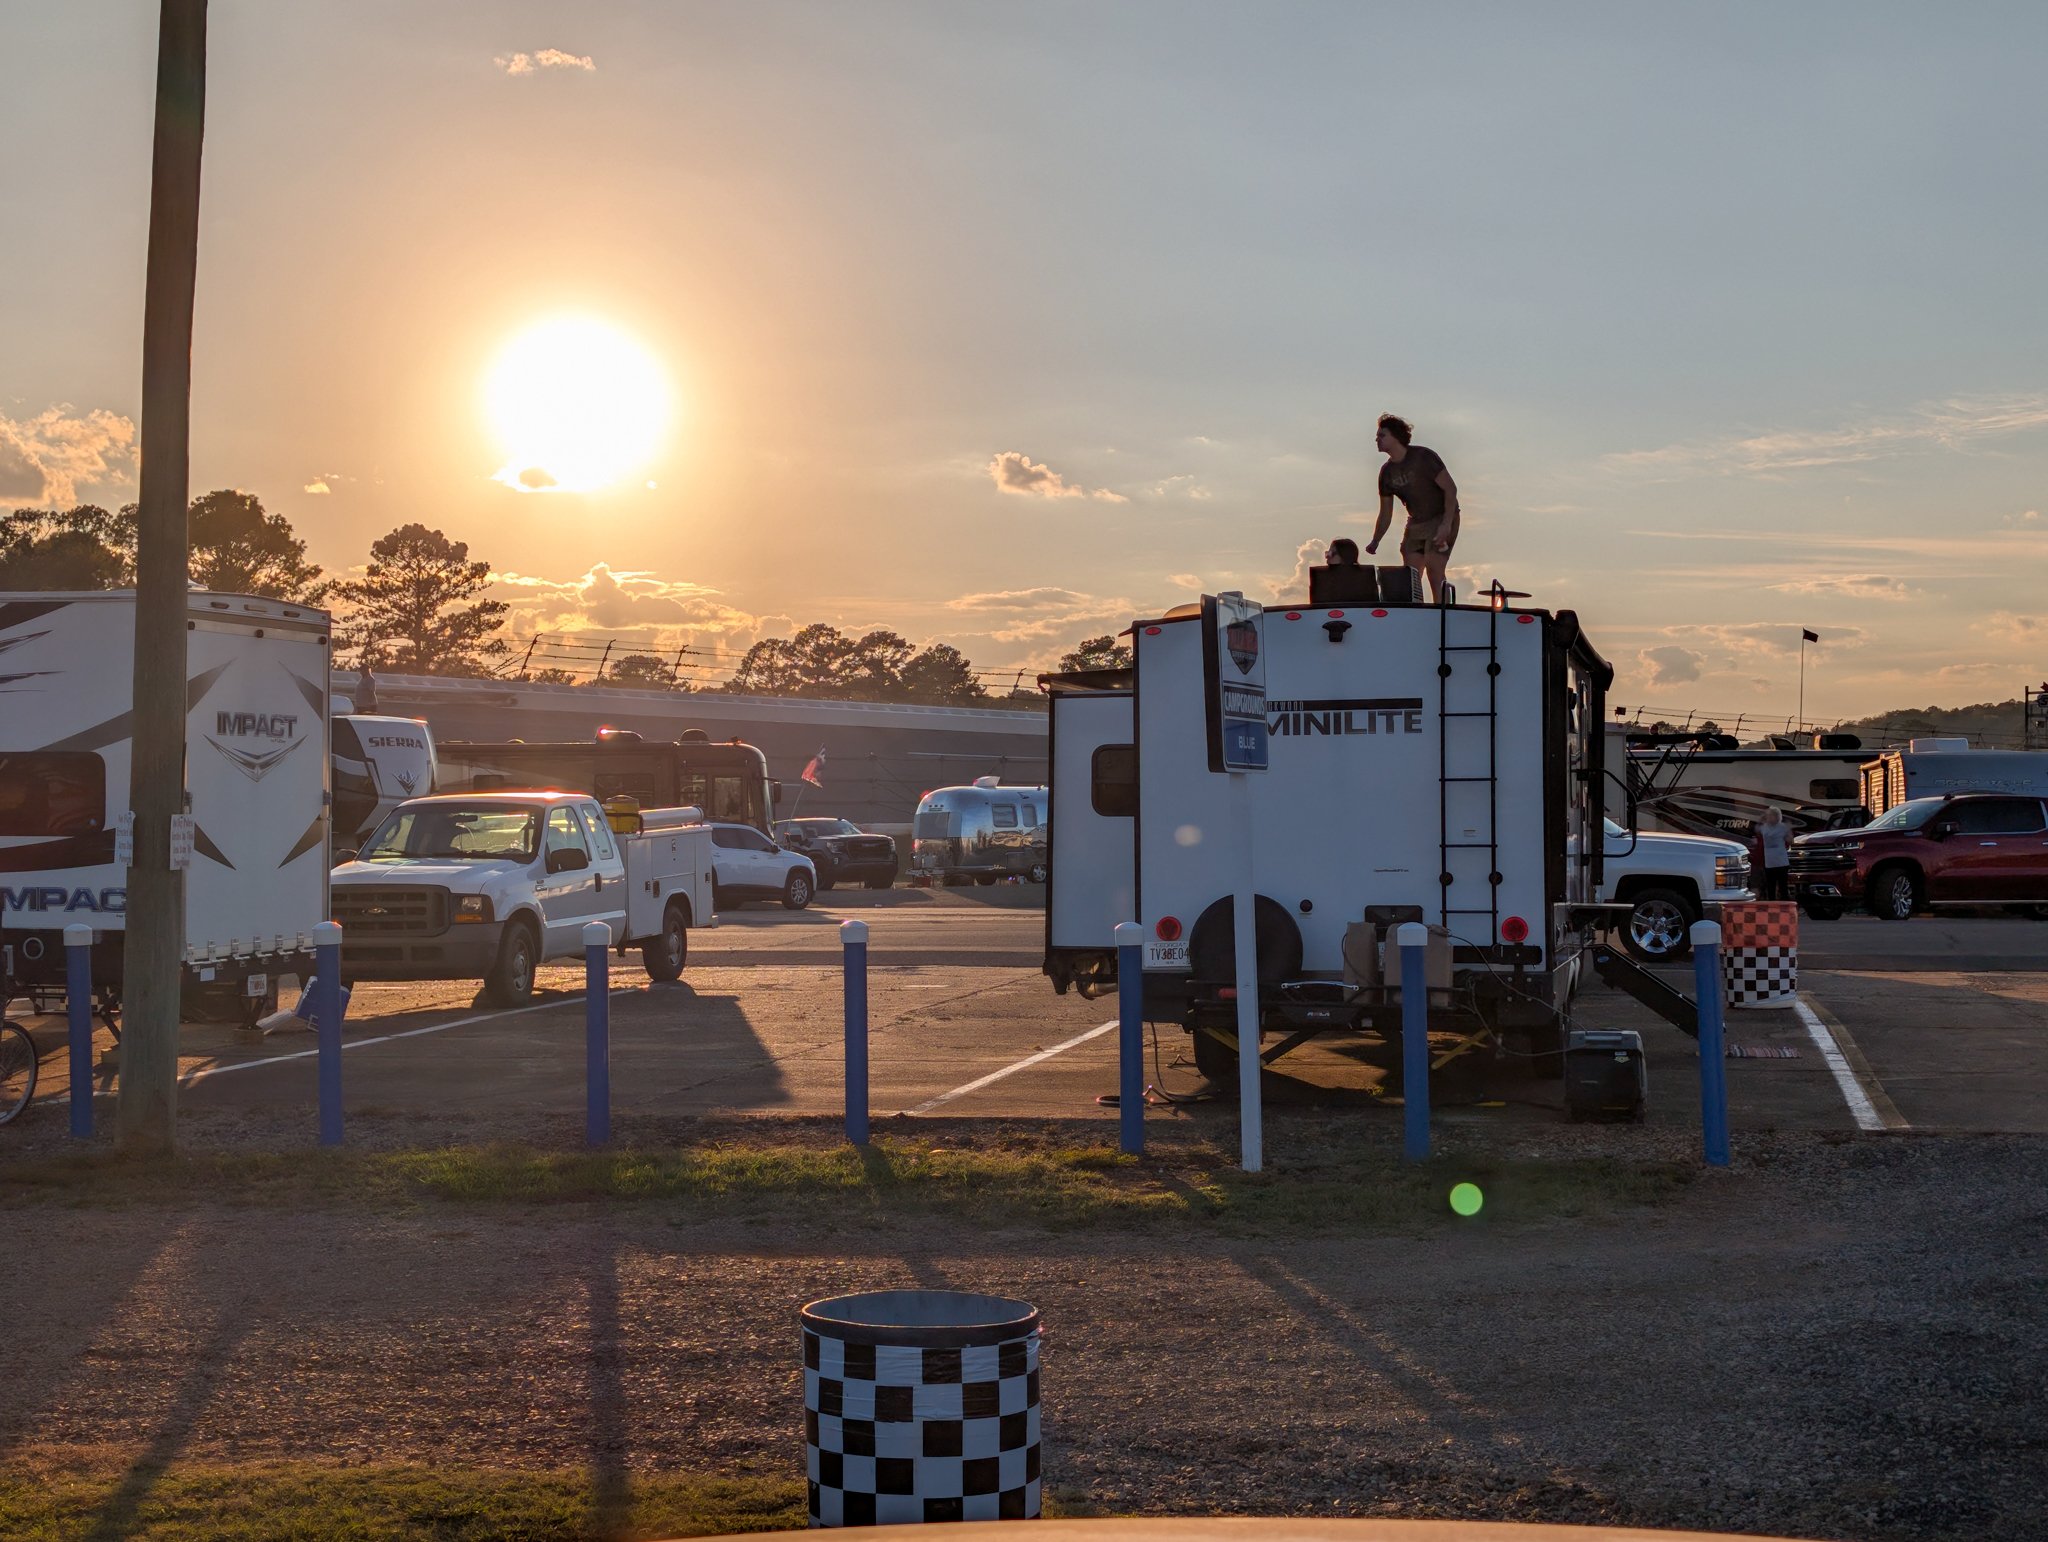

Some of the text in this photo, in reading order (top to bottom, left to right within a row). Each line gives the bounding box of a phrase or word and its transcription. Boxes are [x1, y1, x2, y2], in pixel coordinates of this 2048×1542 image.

[1224, 691, 1265, 716] CAMPGROUNDS
[216, 711, 297, 738] IMPACT
[1267, 709, 1422, 736] MINILITE
[368, 736, 424, 750] SIERRA
[1238, 735, 1256, 750] BLUE
[1715, 818, 1751, 829] STORM
[0, 887, 127, 912] MPAC
